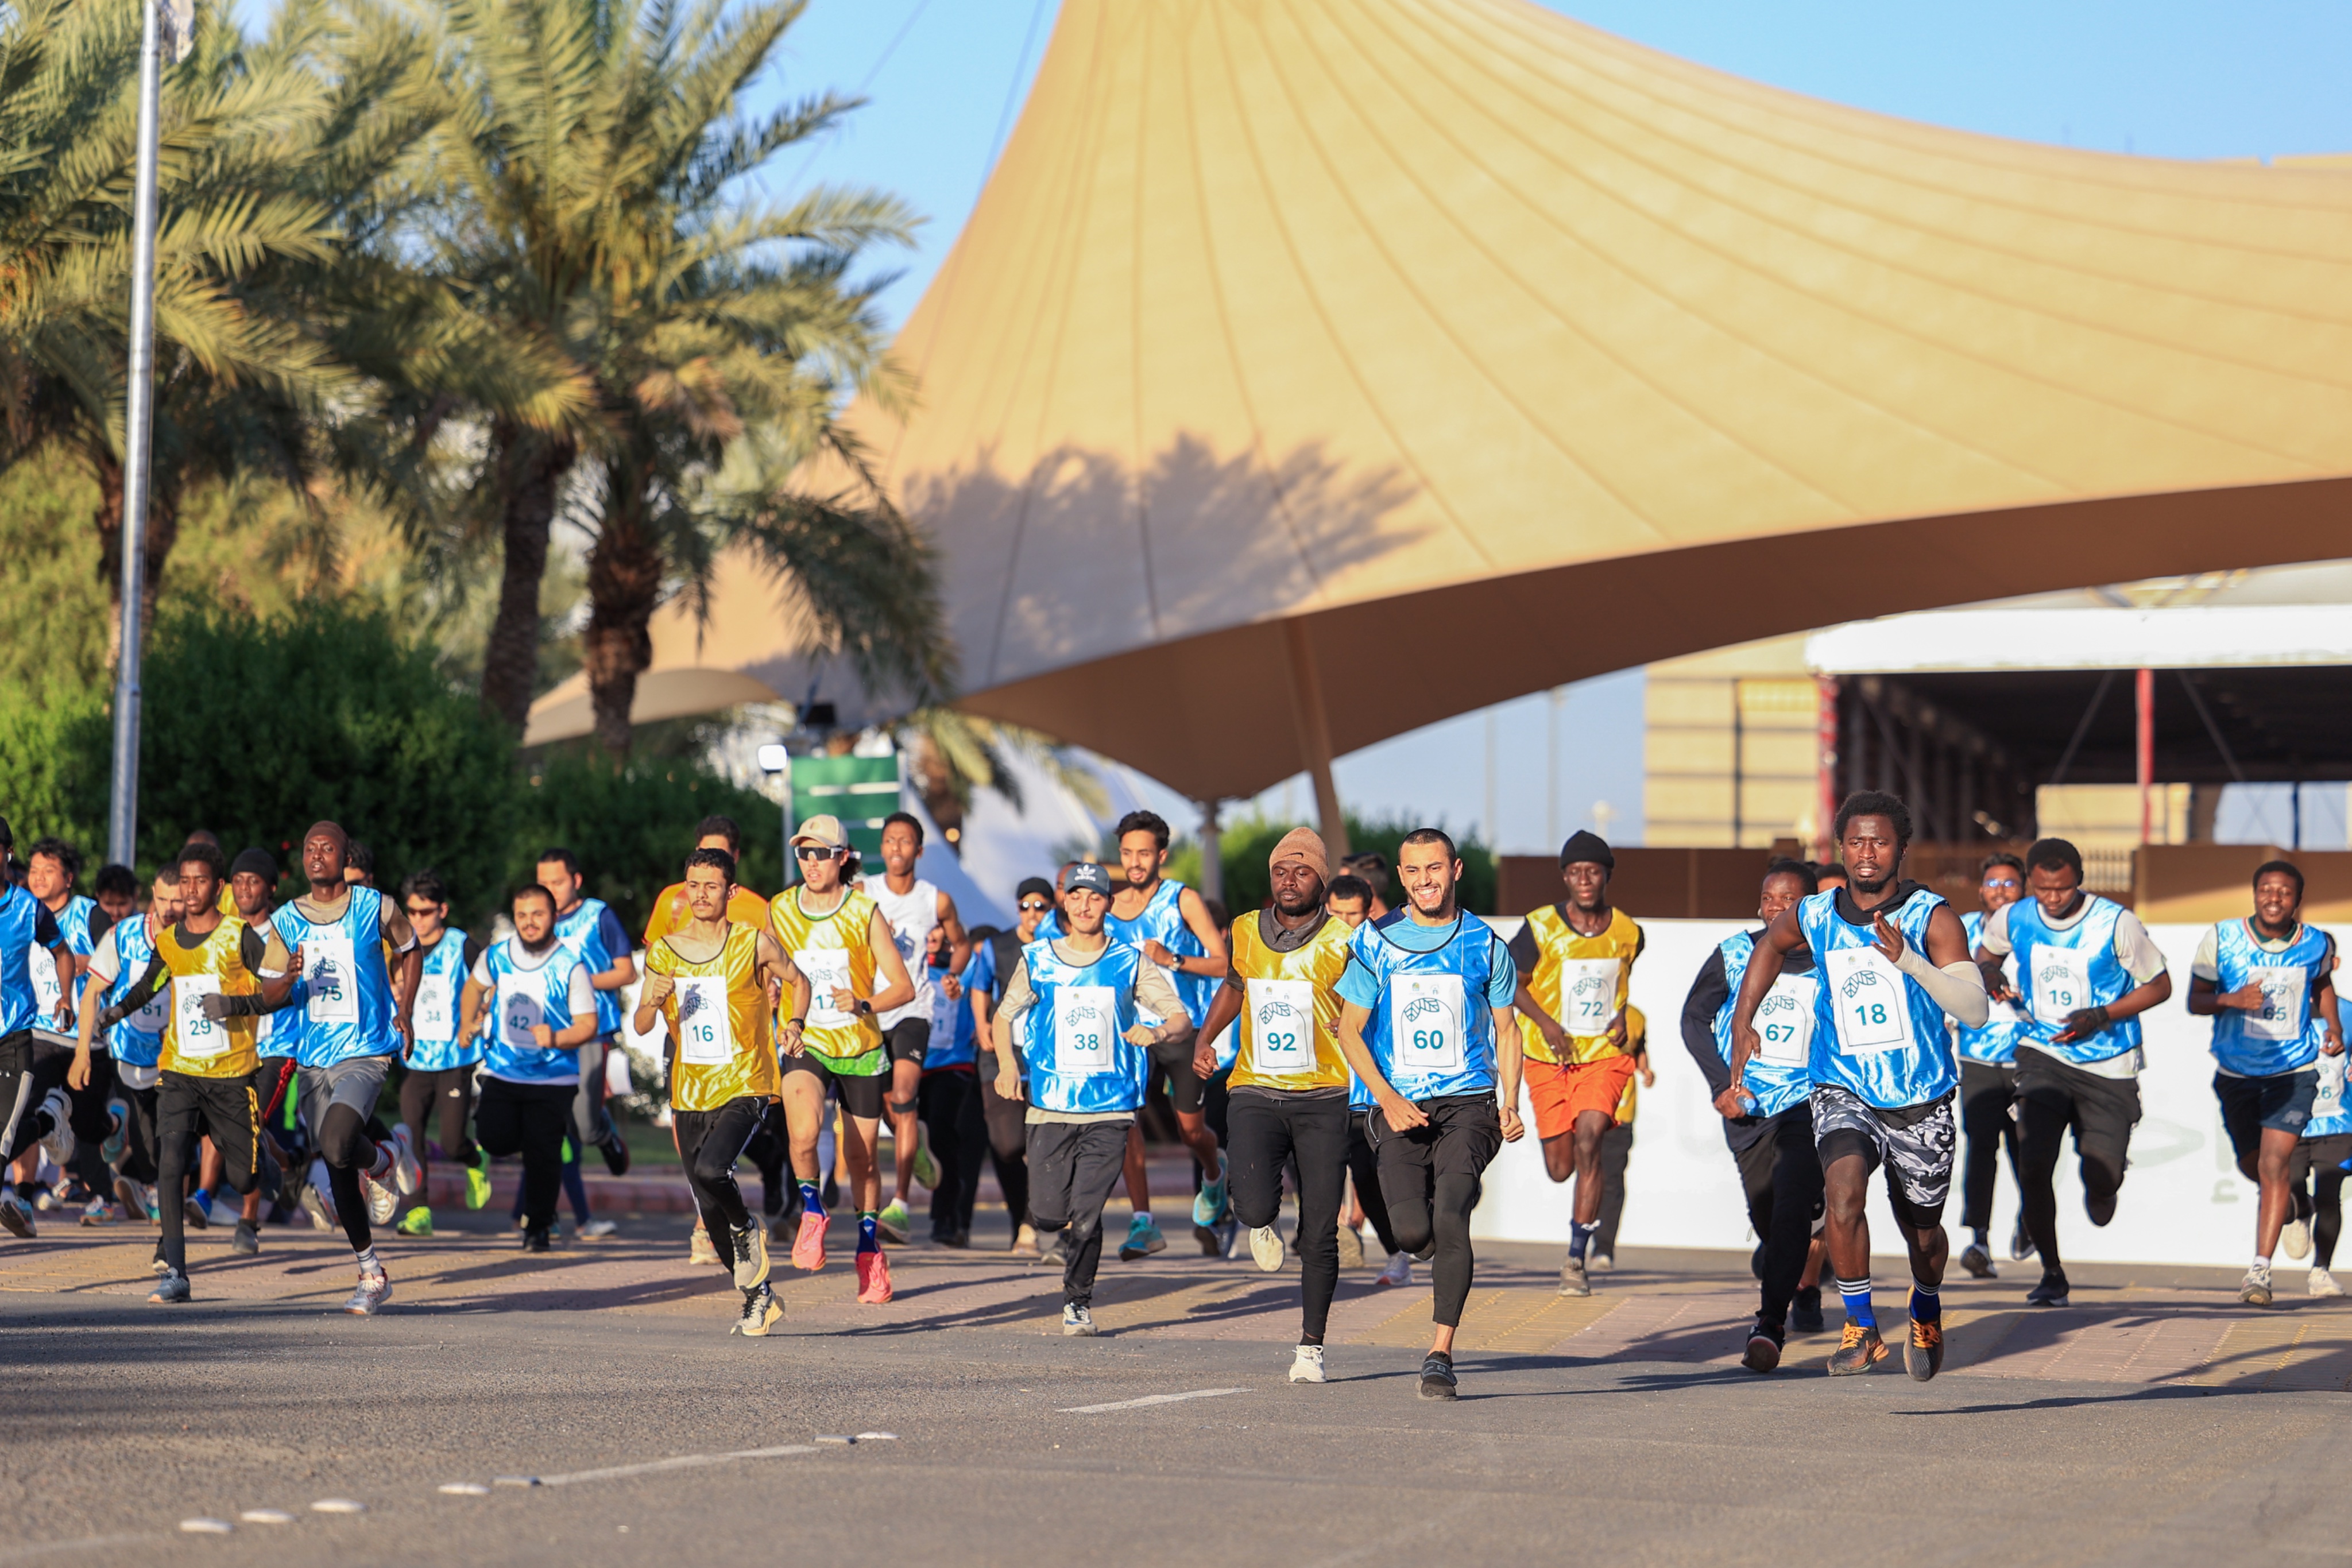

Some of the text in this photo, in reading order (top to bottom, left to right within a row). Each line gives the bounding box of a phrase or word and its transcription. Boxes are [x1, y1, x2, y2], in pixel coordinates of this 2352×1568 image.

[318, 985, 343, 1002] 75
[2049, 990, 2072, 1006] 19
[142, 1003, 161, 1017] 61
[1580, 1001, 1604, 1017] 72
[1855, 1004, 1887, 1026] 18
[2263, 1006, 2287, 1021] 65
[189, 1019, 211, 1035] 29
[509, 1015, 529, 1031] 42
[693, 1025, 714, 1042] 16
[1074, 1033, 1099, 1050] 38
[1267, 1032, 1297, 1051] 92
[1413, 1030, 1444, 1050] 60
[1766, 1024, 1795, 1043] 67
